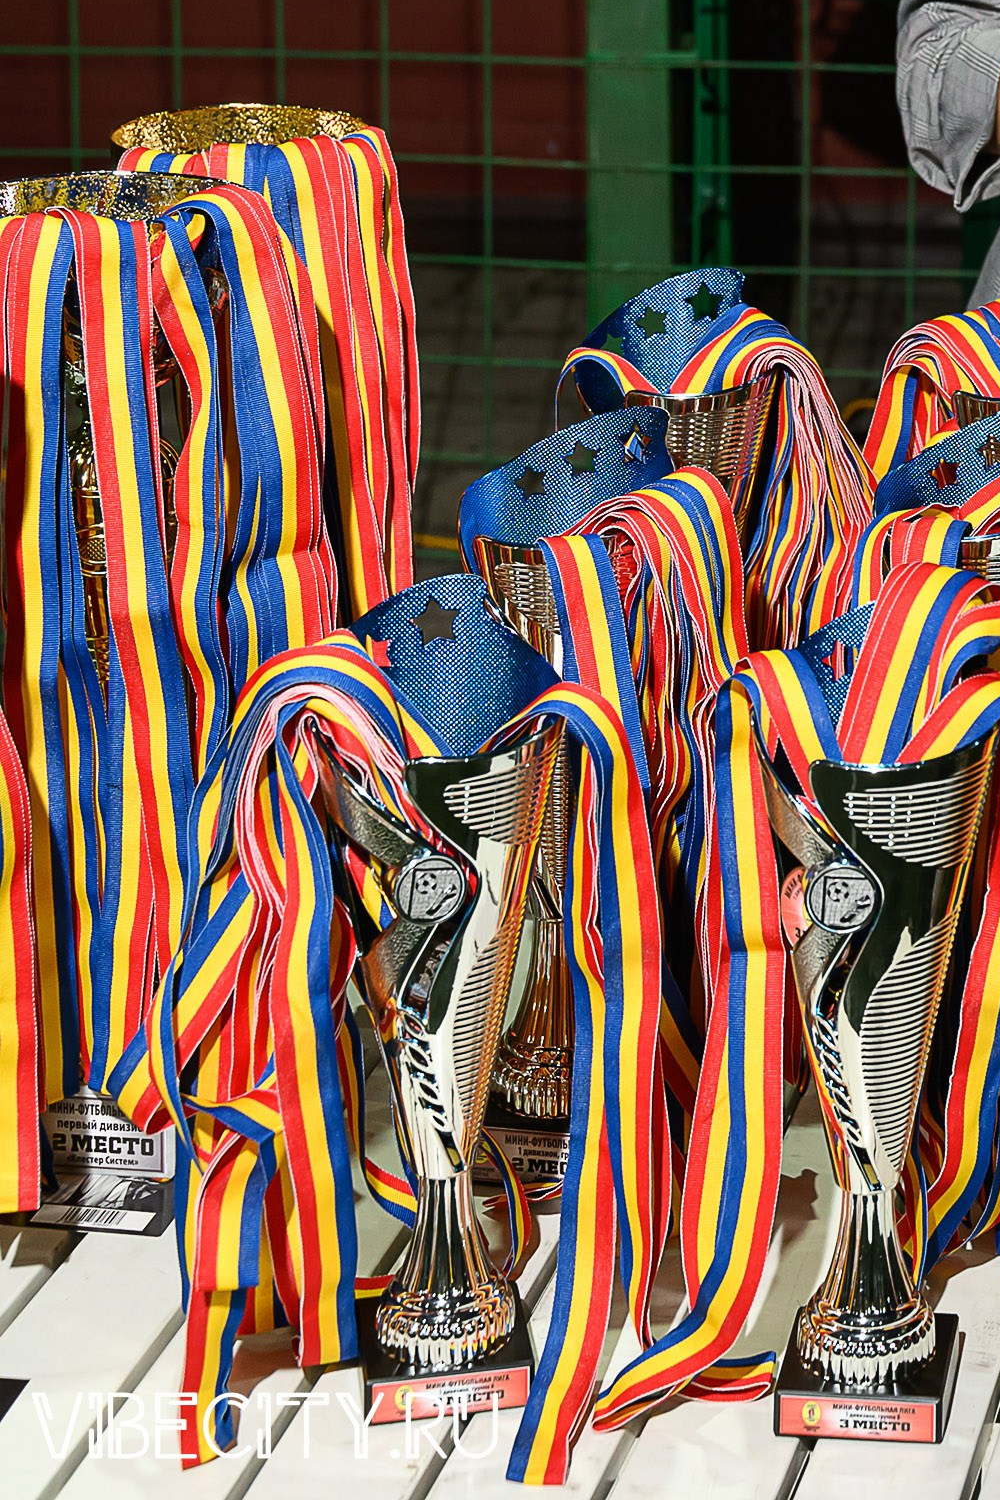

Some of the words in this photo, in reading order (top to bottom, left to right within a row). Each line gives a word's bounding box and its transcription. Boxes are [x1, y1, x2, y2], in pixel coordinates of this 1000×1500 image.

[56, 1119, 97, 1131] первый
[52, 1133, 67, 1151] 2
[71, 1134, 154, 1156] МЕСТО
[505, 1134, 569, 1149] МИНИ-ФУТБОЛЬ
[105, 1156, 139, 1165] Систем»
[512, 1157, 524, 1171] 2
[839, 1419, 849, 1428] 3
[853, 1419, 911, 1432] МЕСТО
